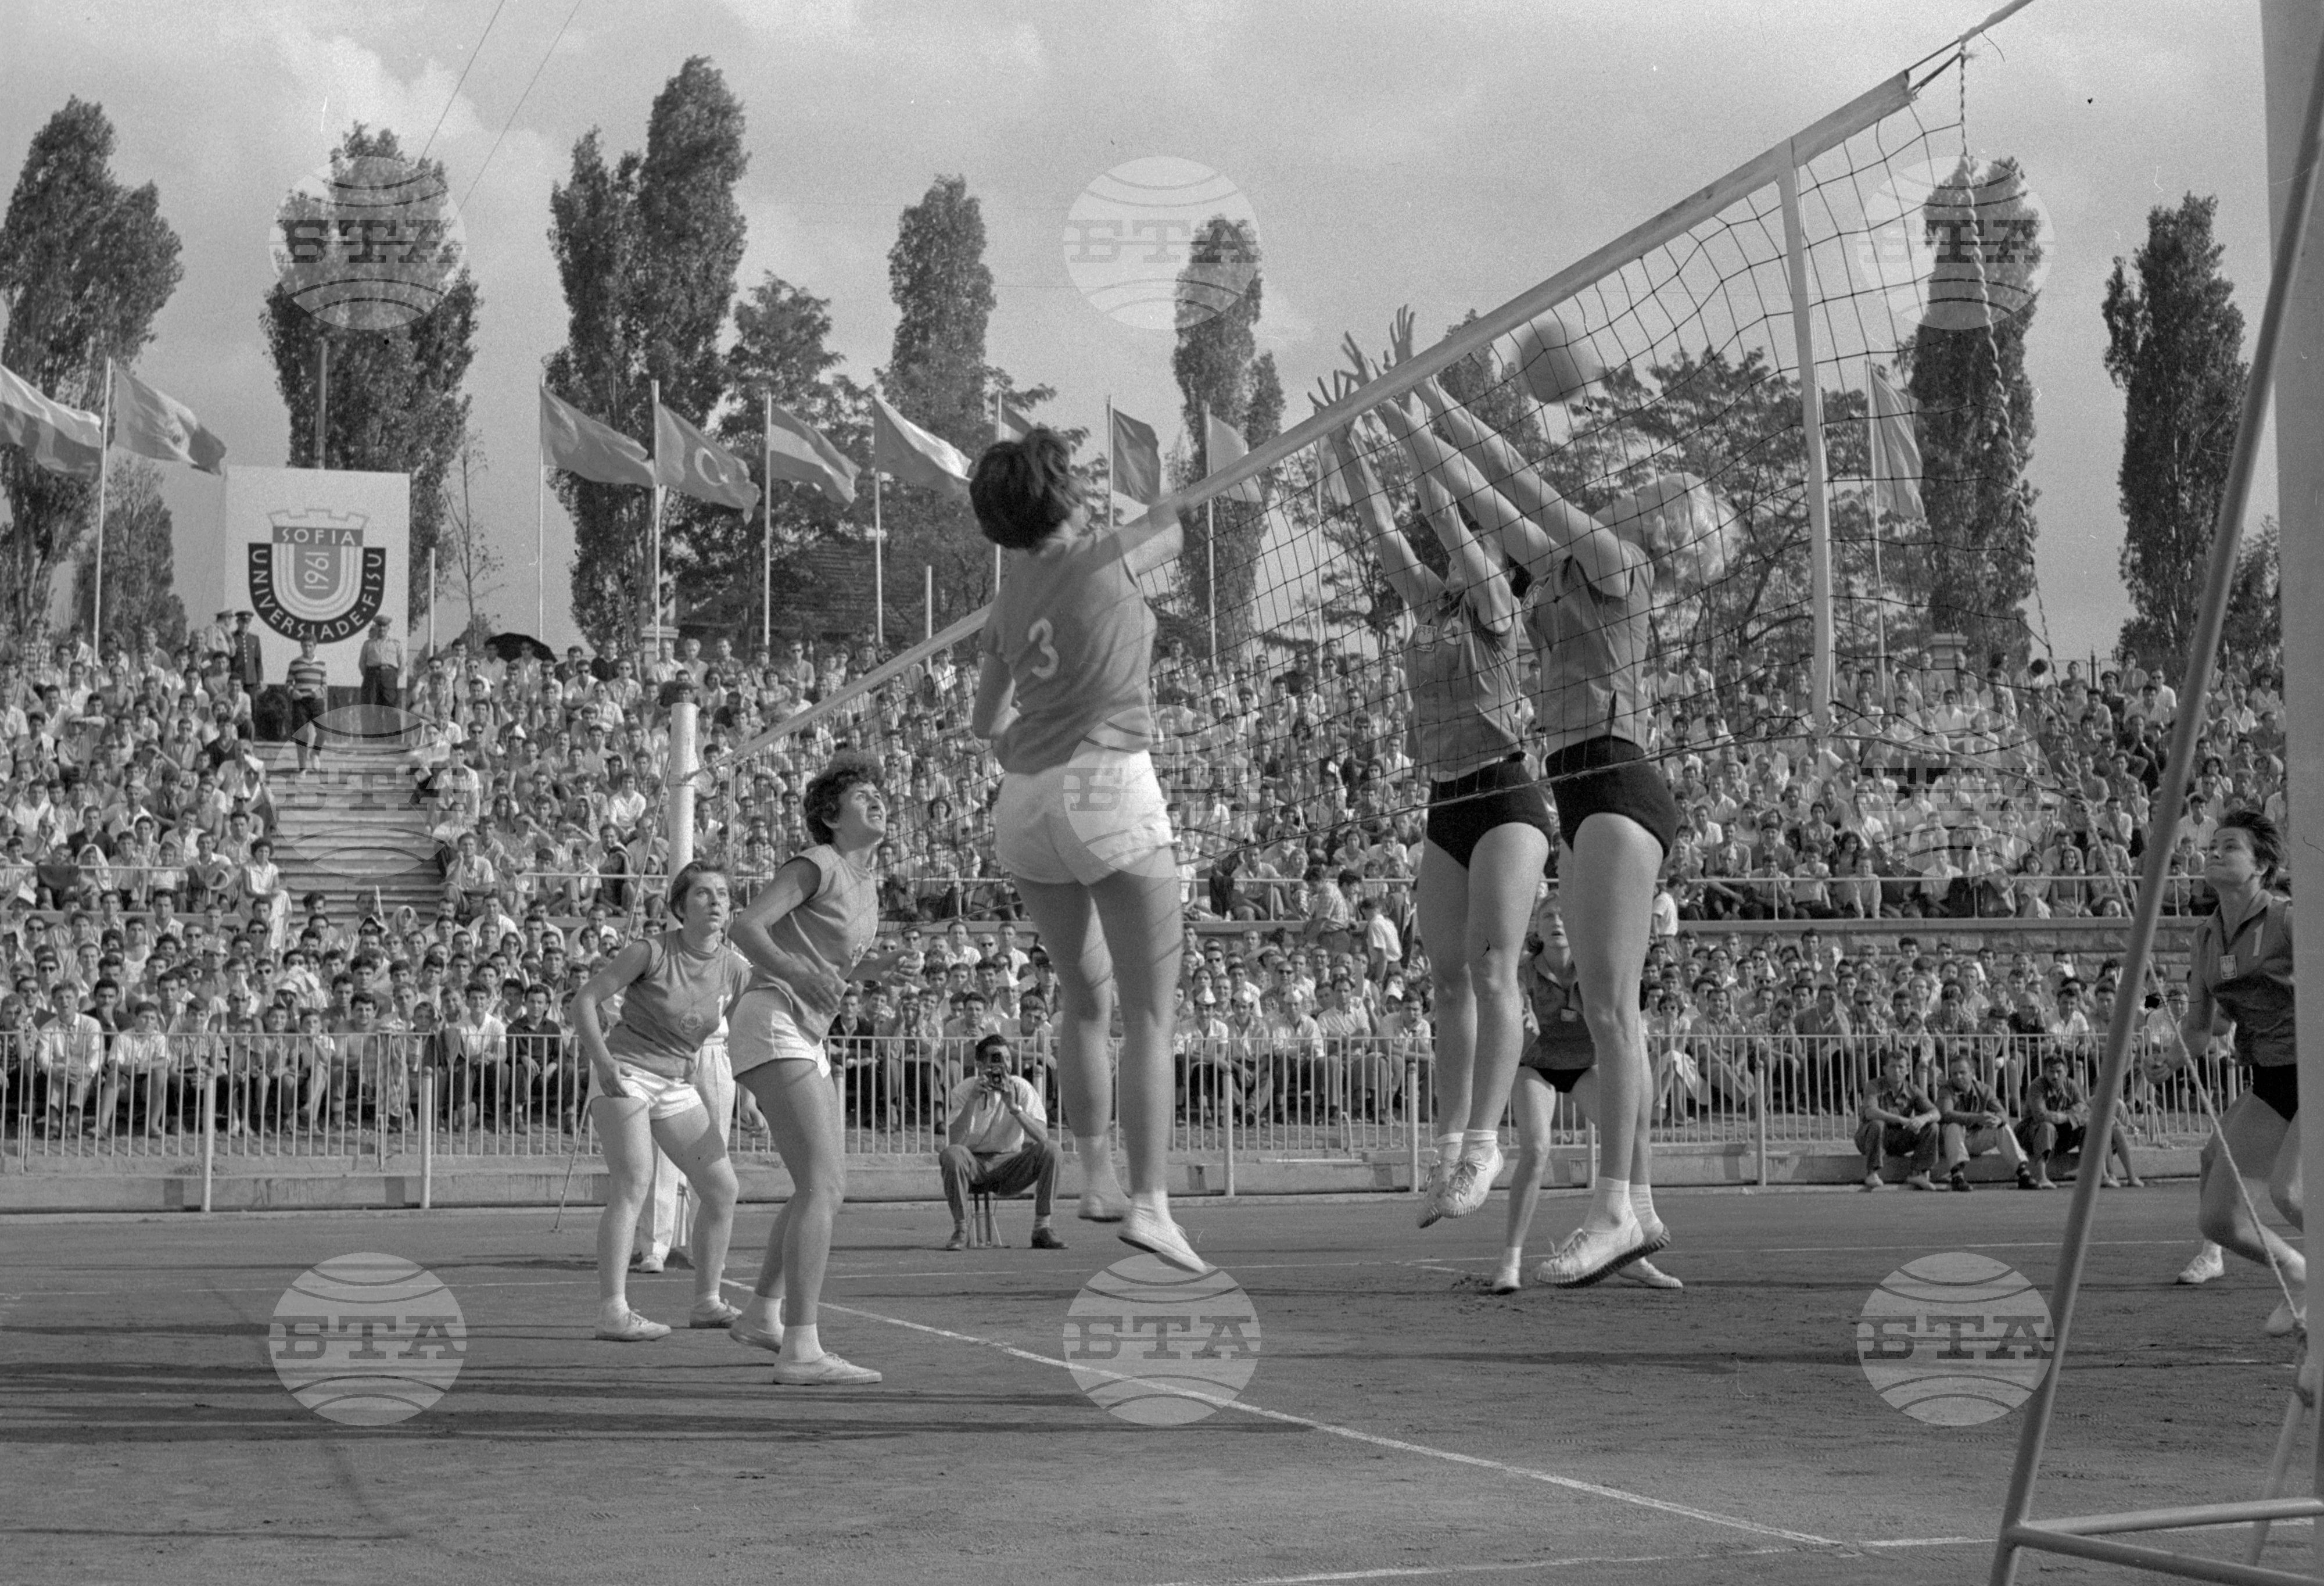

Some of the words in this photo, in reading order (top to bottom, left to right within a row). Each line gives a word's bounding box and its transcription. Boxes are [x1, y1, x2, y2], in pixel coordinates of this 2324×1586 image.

[282, 528, 356, 545] SOFIA
[304, 552, 329, 589] 1961
[252, 549, 364, 639] UNIVERSIADE
[362, 554, 382, 607] FISU
[1028, 617, 1060, 680] 3
[2253, 921, 2264, 957] 1
[716, 994, 733, 1024] 1
